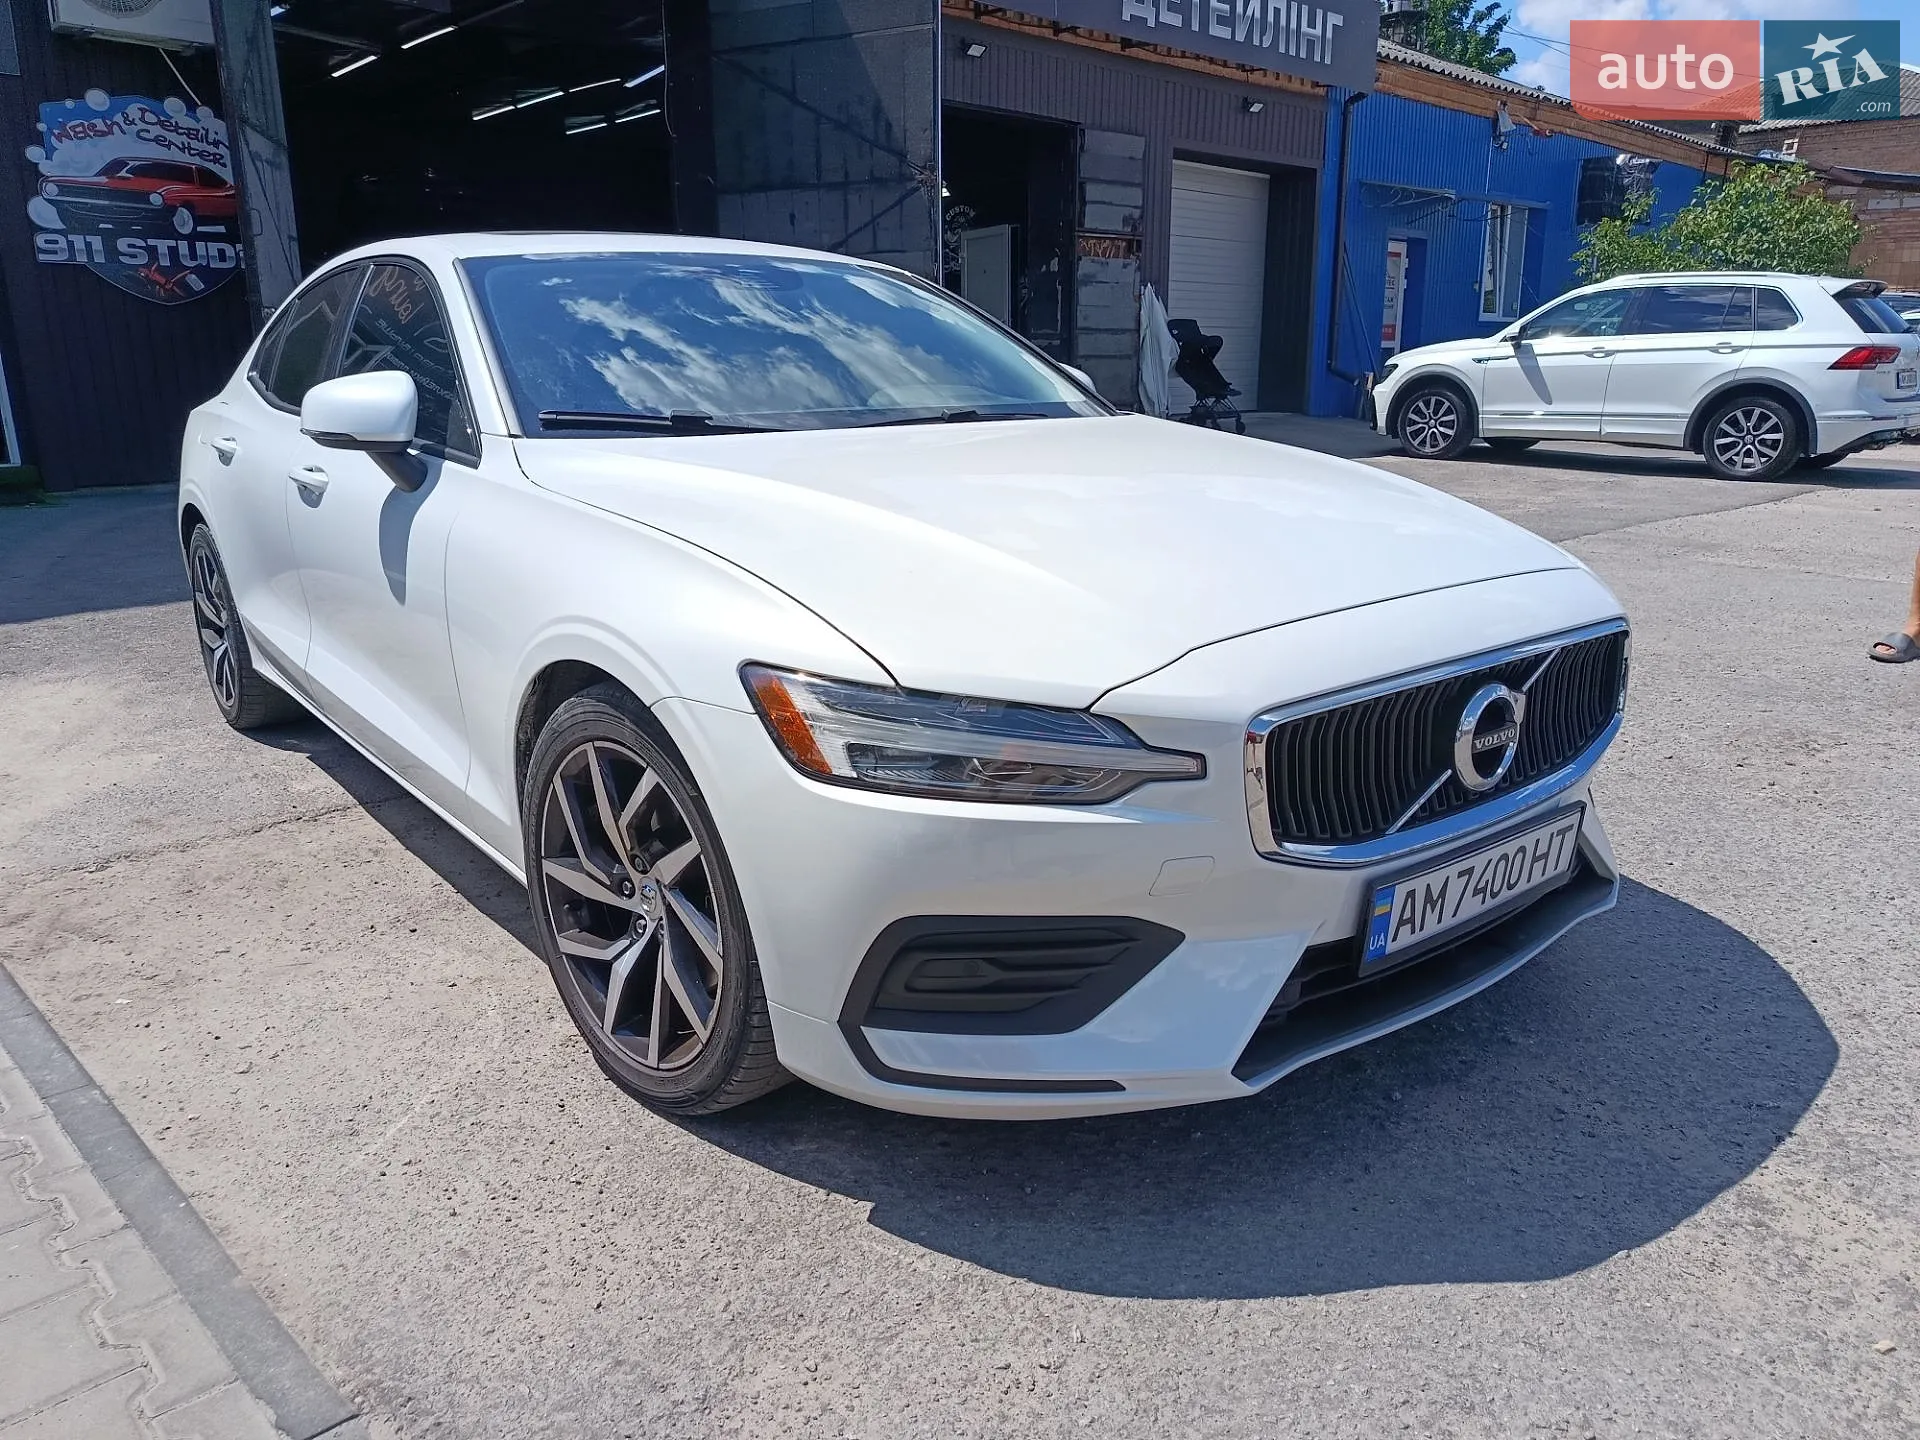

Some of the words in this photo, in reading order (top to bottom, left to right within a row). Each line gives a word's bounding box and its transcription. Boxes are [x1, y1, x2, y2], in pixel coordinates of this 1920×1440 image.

[137, 107, 229, 150] Detailin
[35, 233, 106, 264] 911
[1472, 728, 1515, 749] VOLVO
[1368, 933, 1386, 950] UA
